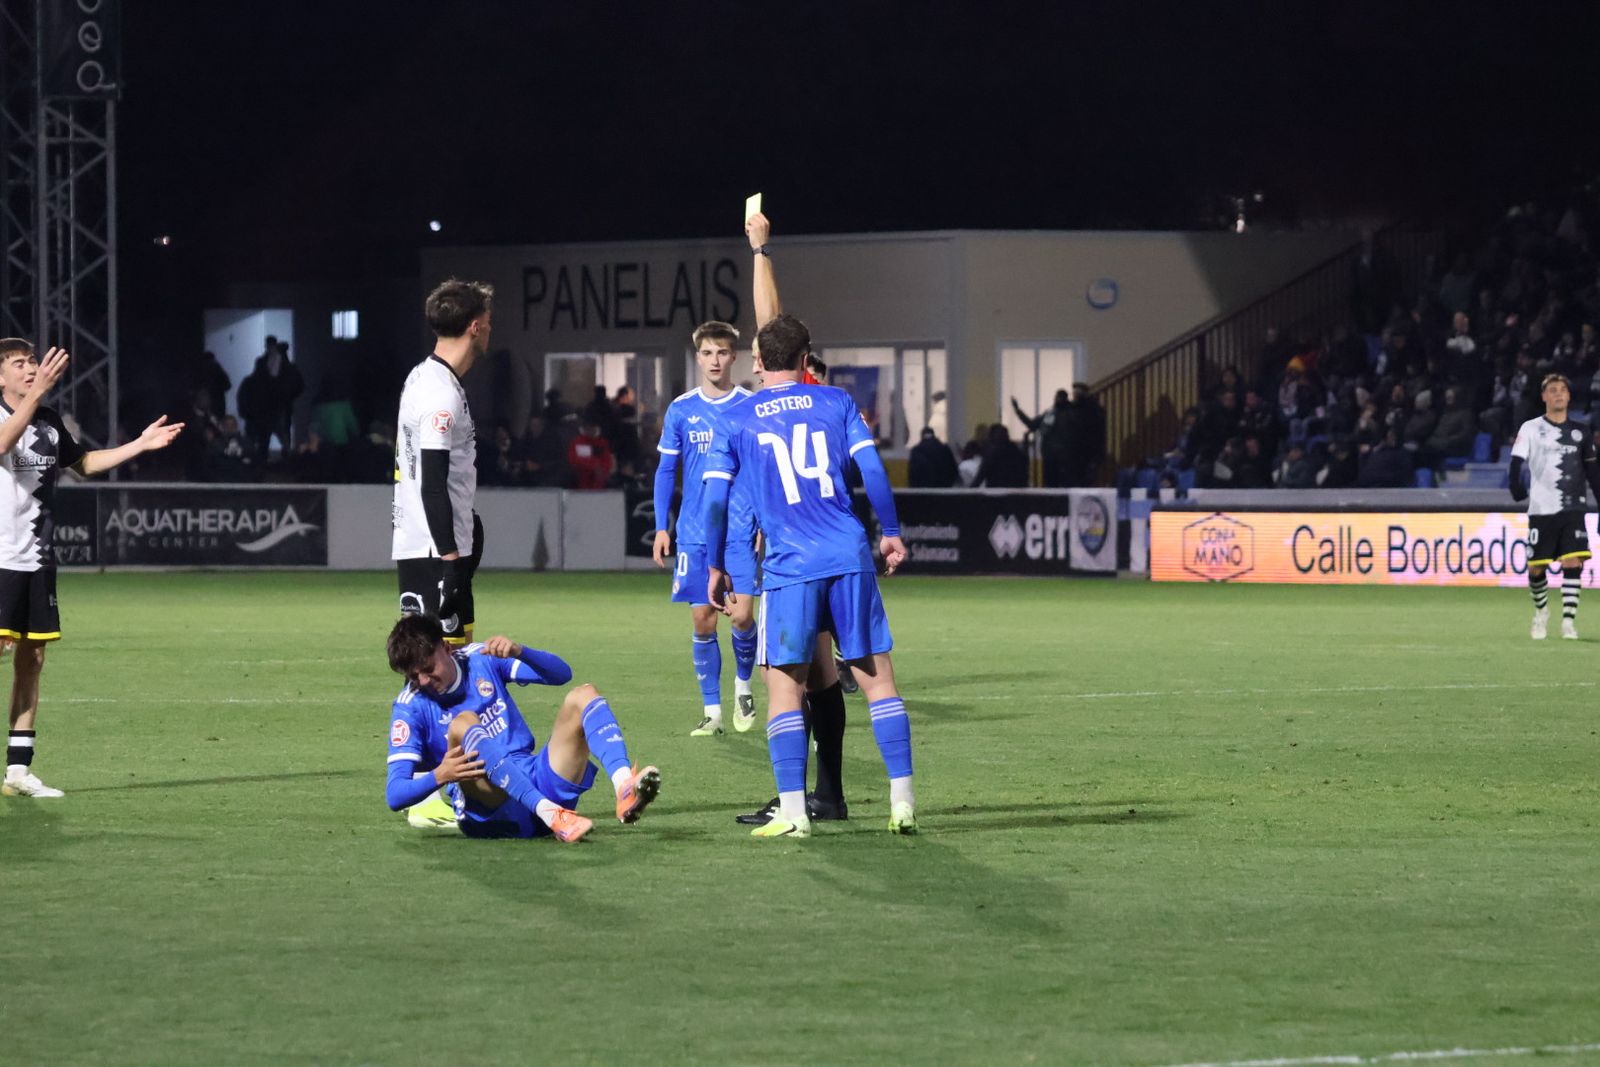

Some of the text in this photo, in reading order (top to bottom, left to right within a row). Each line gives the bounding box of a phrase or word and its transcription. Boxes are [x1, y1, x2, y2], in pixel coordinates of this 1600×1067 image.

[522, 257, 740, 331] PANELAIS
[754, 395, 813, 418] CESTERO
[757, 423, 835, 505] 14
[105, 504, 307, 537] AQUATHERAPIA
[148, 536, 219, 548] CENTER
[1194, 545, 1243, 566] MANO
[1292, 525, 1374, 574] Calle
[479, 697, 508, 726] ates
